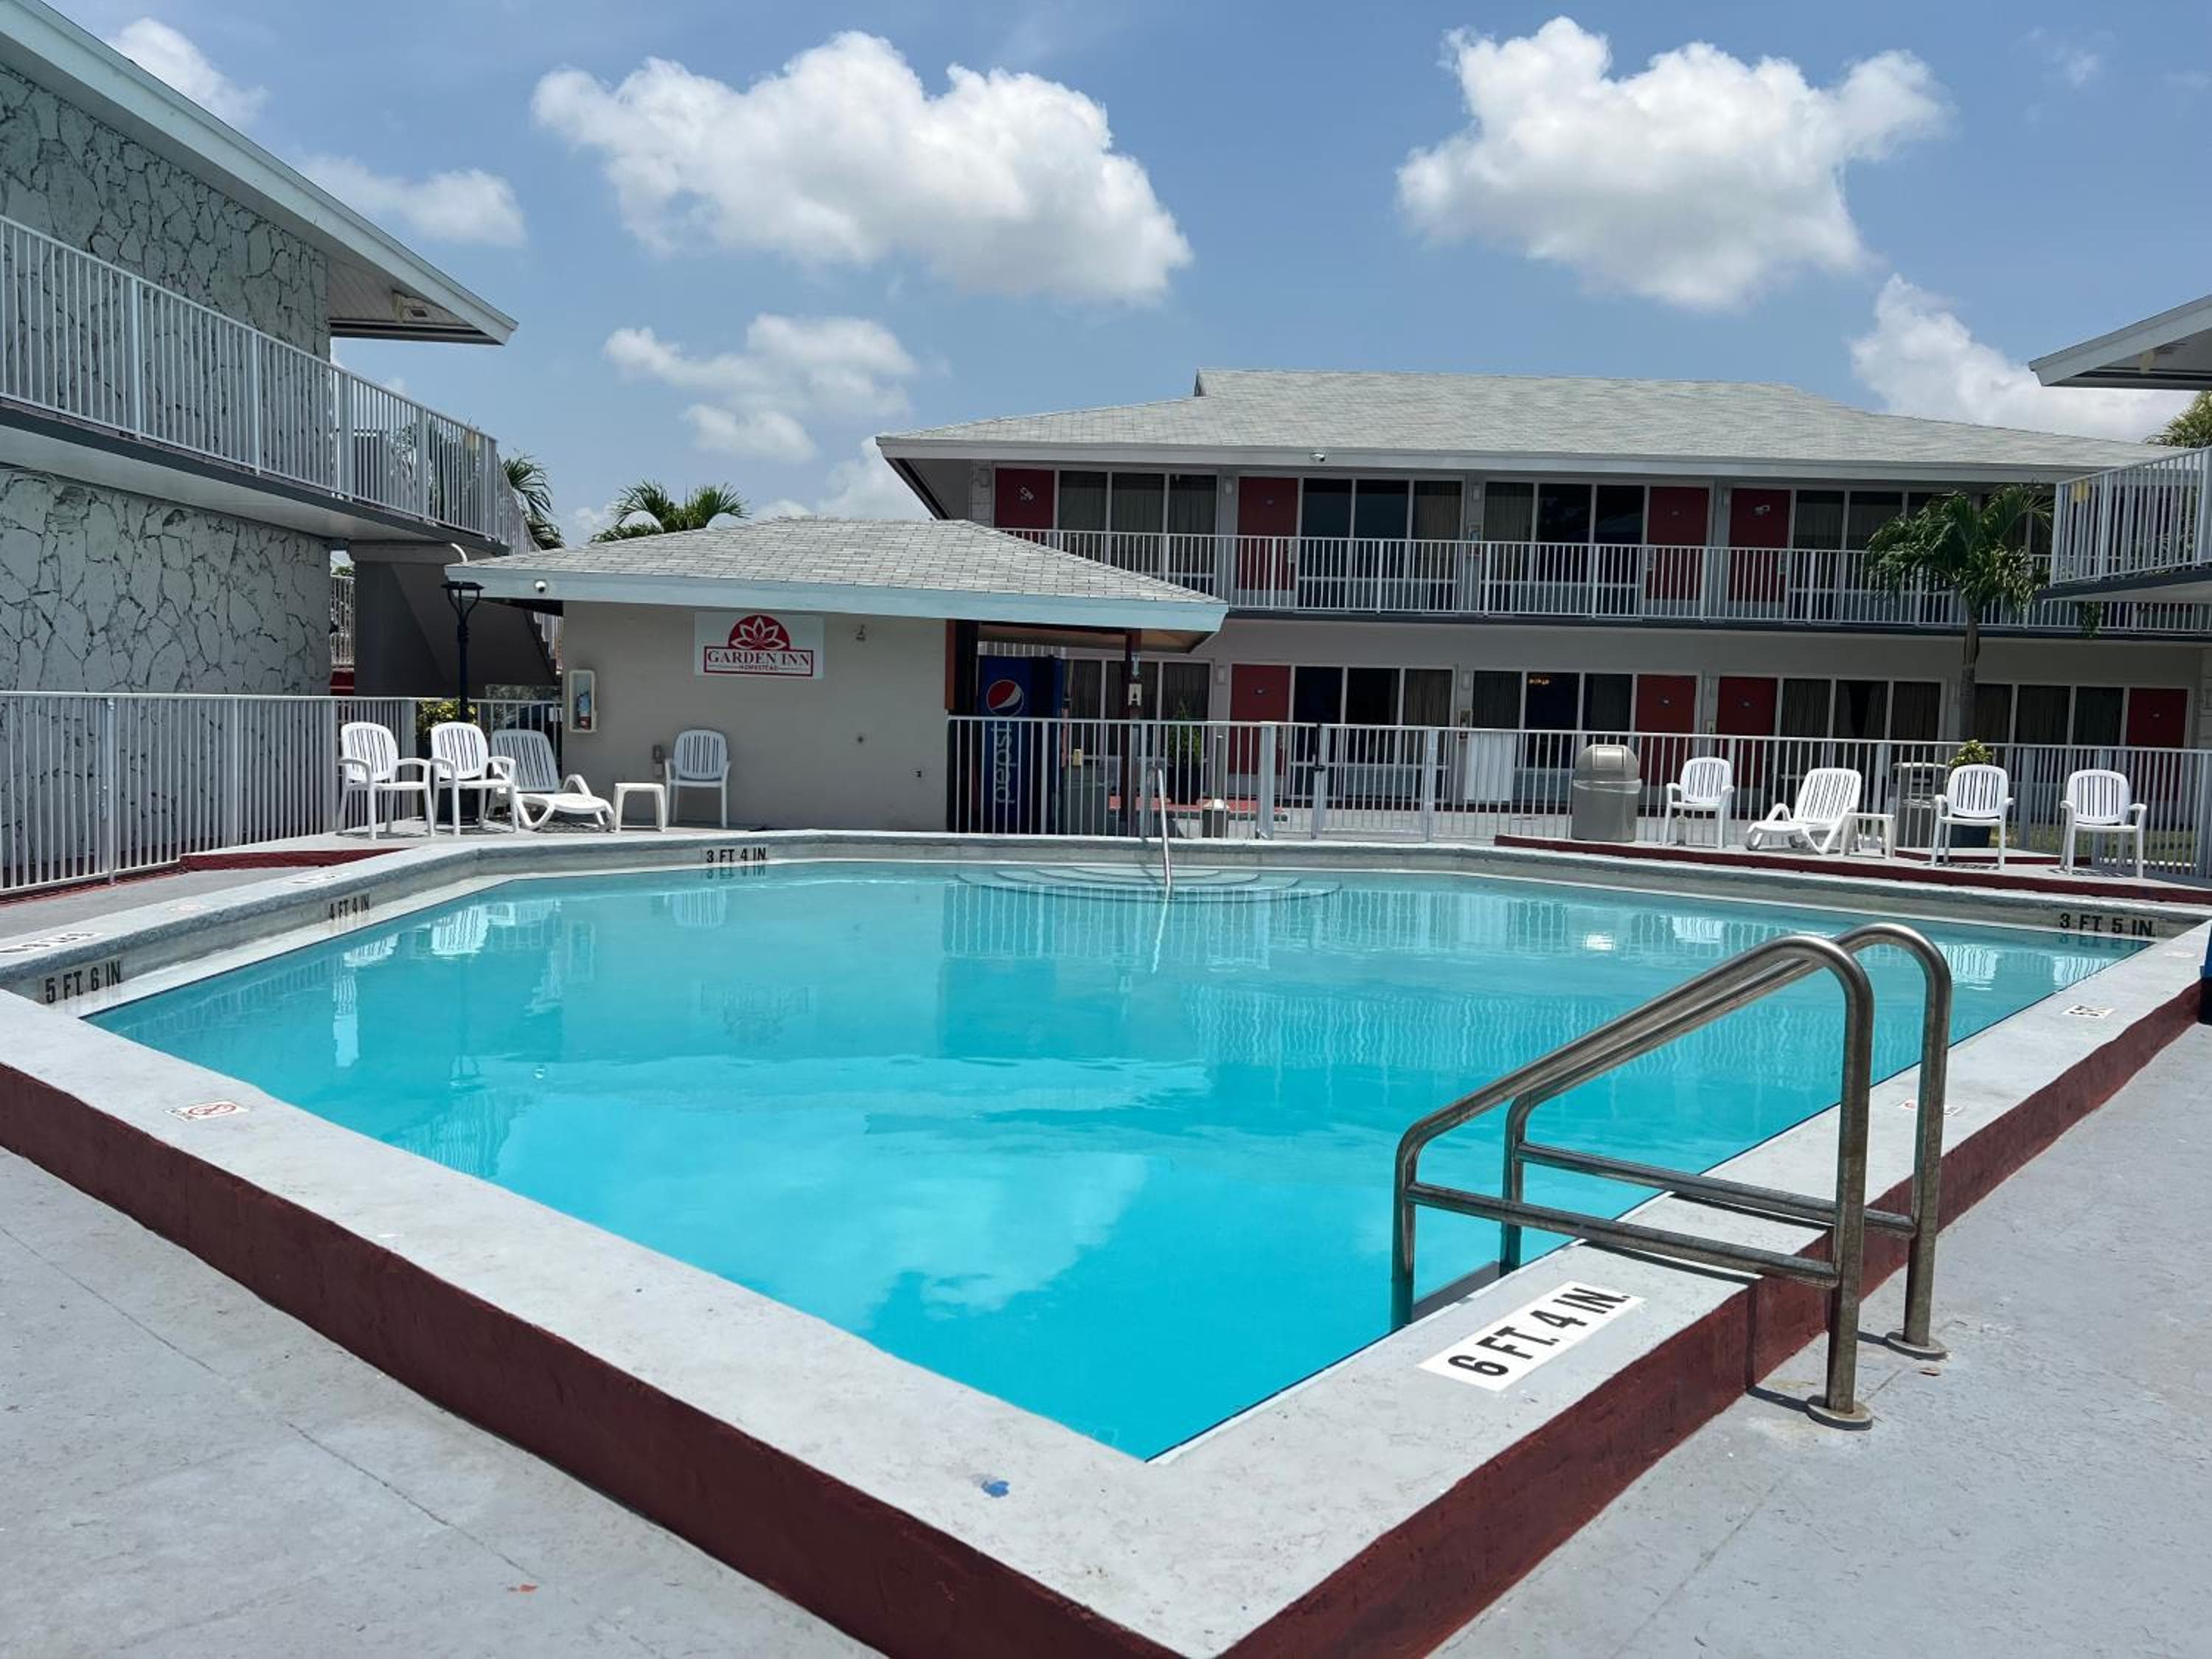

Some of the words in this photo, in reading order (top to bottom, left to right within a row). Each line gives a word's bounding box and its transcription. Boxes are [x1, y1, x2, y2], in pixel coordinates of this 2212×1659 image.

[708, 650, 776, 664] GARDEN
[779, 653, 810, 666] INN
[990, 723, 1017, 804] pepsi
[706, 849, 714, 863] 3
[740, 847, 748, 861] 4
[2059, 913, 2070, 928] 3
[2111, 917, 2124, 933] 5
[45, 977, 55, 1004] 5
[90, 967, 100, 992] 6
[1552, 1287, 1632, 1315] IN.
[1529, 1310, 1587, 1329] 4
[1475, 1325, 1561, 1360] FT.
[1447, 1354, 1509, 1377] 6
